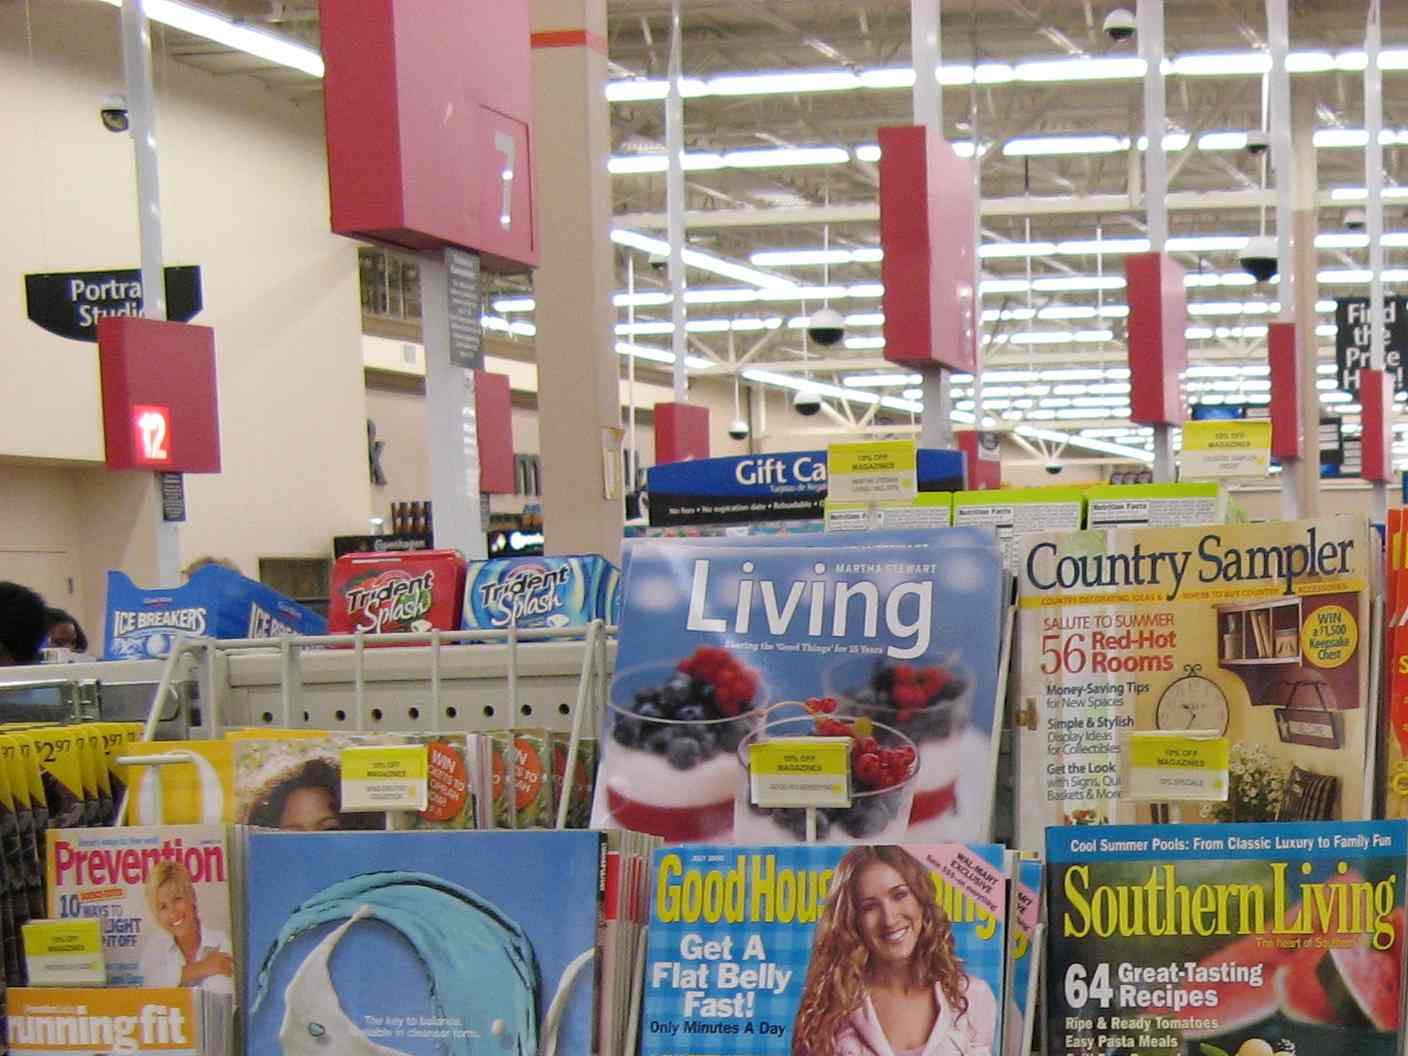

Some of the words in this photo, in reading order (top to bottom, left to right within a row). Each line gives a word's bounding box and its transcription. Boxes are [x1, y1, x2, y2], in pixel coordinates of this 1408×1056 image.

[71, 279, 143, 300] Portra
[138, 412, 167, 459] 12
[736, 461, 786, 484] Gift
[836, 564, 882, 574] MARTHA
[1027, 542, 1191, 601] Country
[1199, 528, 1353, 594] Sampler
[347, 570, 434, 612] Trident
[481, 564, 569, 605] Trident
[115, 611, 136, 637] ICE
[139, 608, 207, 633] BREAKERS
[357, 593, 428, 632] Splash
[492, 593, 563, 624] Splash
[686, 560, 932, 658] Living
[1044, 616, 1090, 631] SALUTE
[1095, 616, 1112, 628] TO
[1116, 614, 1174, 628] SUMMER
[1041, 634, 1085, 674] 56
[1092, 631, 1177, 649] Red-Hot
[1092, 652, 1173, 672] Rooms
[1071, 839, 1097, 852] Cool
[1100, 838, 1148, 851] Summer
[1152, 837, 1189, 850] Pools:
[1194, 838, 1223, 849] From
[1228, 837, 1270, 848] Classic
[1275, 835, 1314, 849] Luxury
[1318, 836, 1329, 847] to
[1334, 835, 1368, 848] Family
[1373, 834, 1391, 846] Fun
[1064, 865, 1264, 938] Southern
[1270, 862, 1396, 949] Living
[680, 934, 733, 960] Get
[743, 935, 765, 959] A
[652, 963, 708, 988] Flat
[717, 963, 791, 994] Belly
[1064, 962, 1113, 1008] 64
[1119, 962, 1263, 986] Great-Tasting
[683, 994, 754, 1018] Fast!
[1120, 984, 1218, 1010] Recipes
[650, 1021, 679, 1034] Only
[684, 1021, 738, 1034] Minutes
[744, 1022, 755, 1033] A
[759, 1022, 785, 1035] Day
